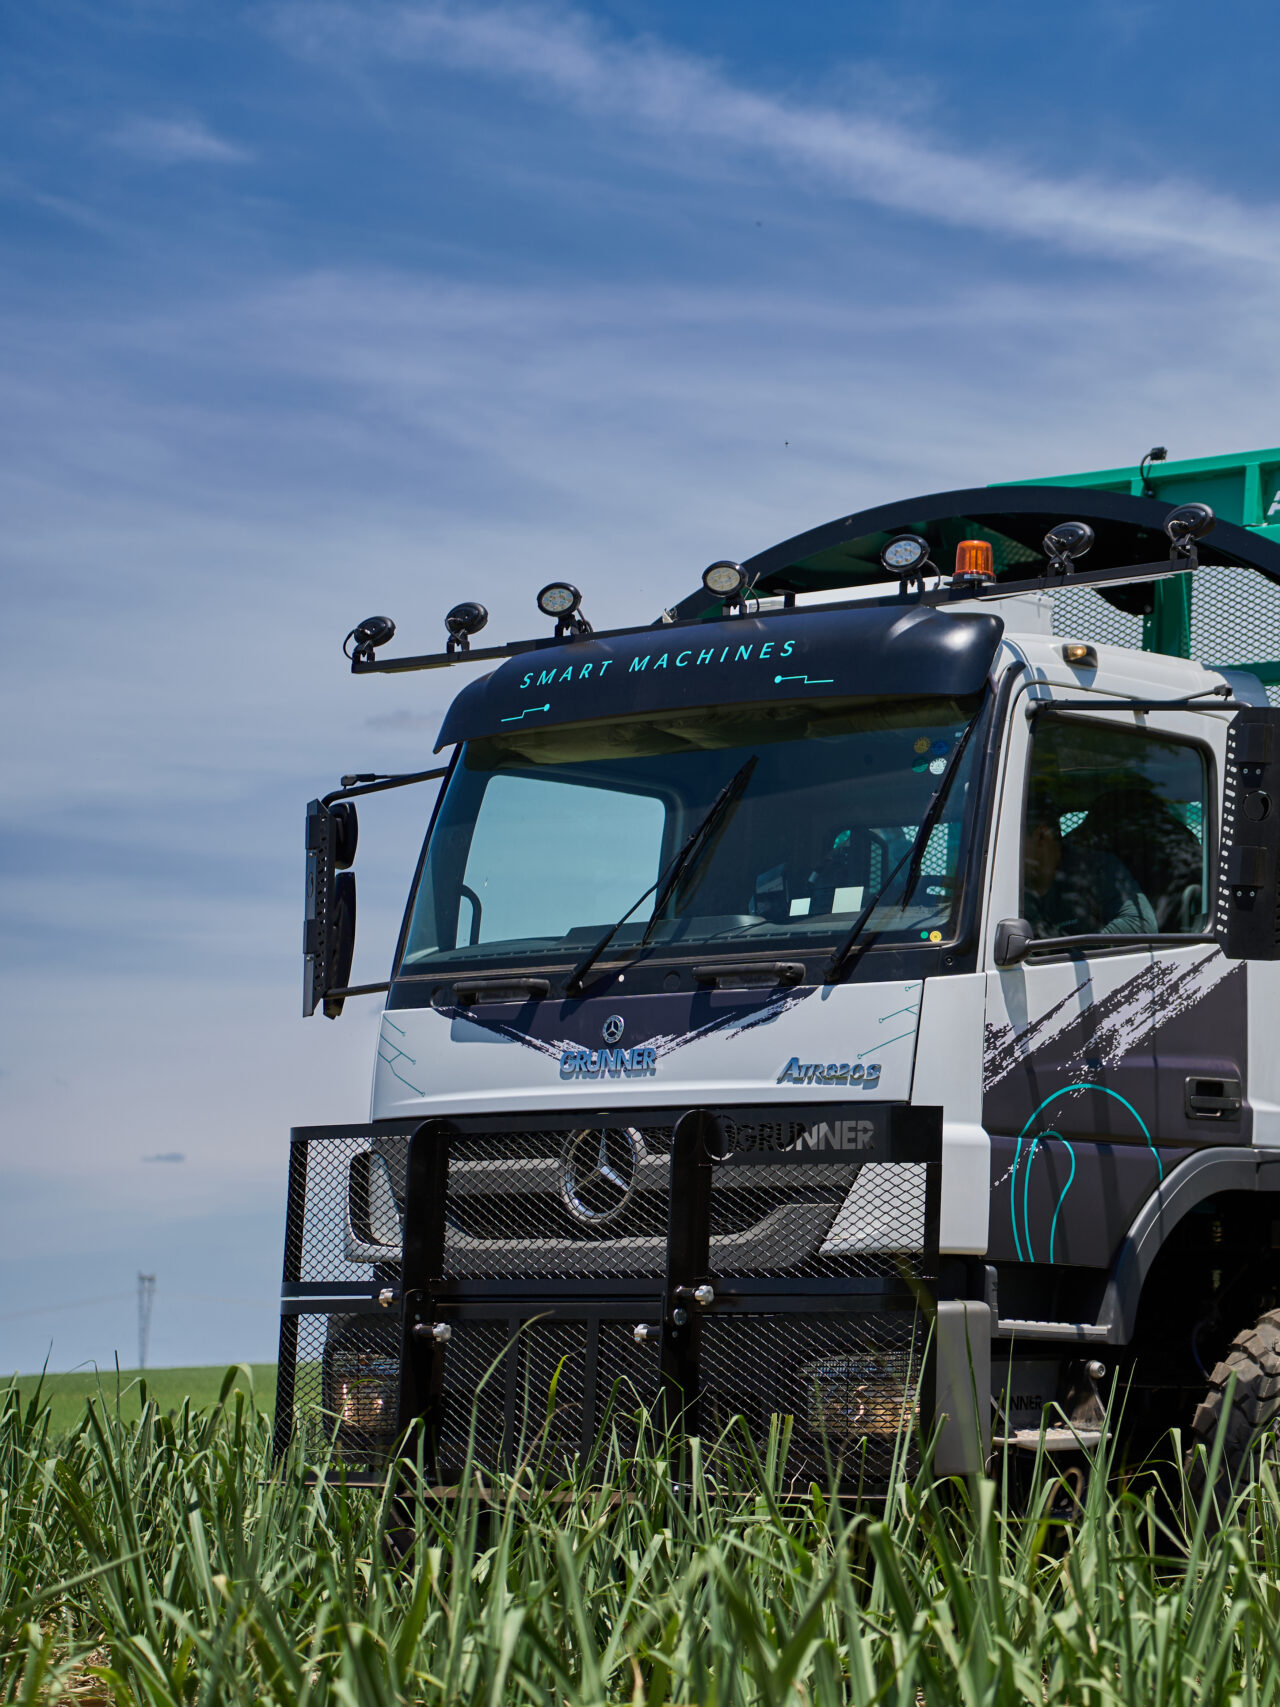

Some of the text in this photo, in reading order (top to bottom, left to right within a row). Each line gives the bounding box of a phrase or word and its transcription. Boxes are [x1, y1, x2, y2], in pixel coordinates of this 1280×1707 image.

[519, 639, 796, 689] SMART MACHINES
[560, 1047, 657, 1074] GRUNNER
[736, 1119, 876, 1152] GRUNNER
